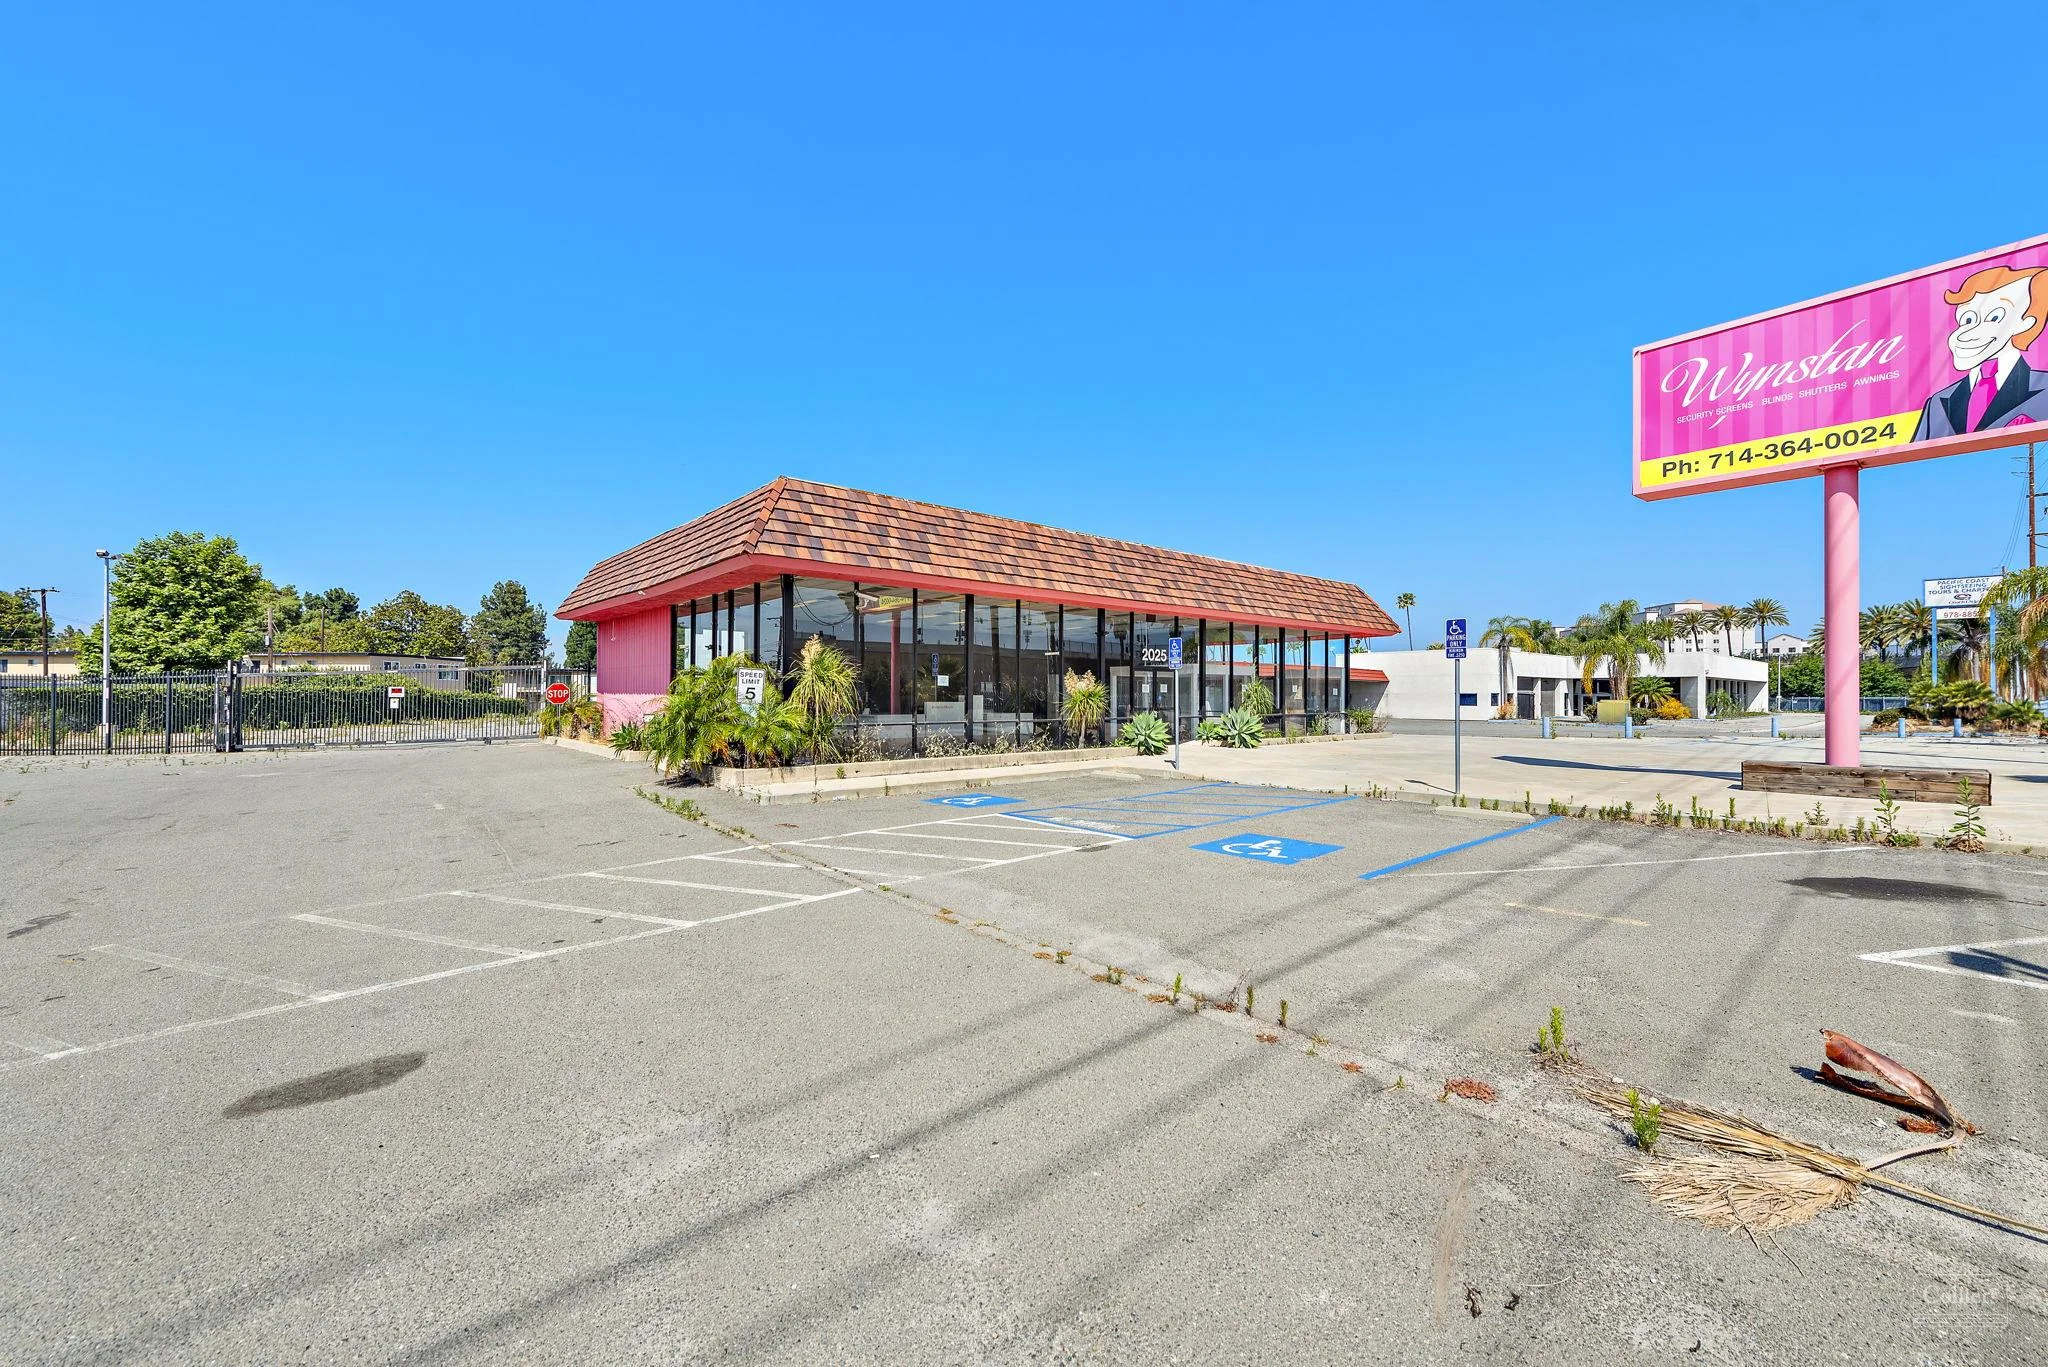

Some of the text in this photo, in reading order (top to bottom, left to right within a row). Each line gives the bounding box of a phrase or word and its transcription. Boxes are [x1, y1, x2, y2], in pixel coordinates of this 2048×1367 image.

[1661, 319, 1906, 429] Wynstan
[1676, 370, 1900, 424] SECURITY SCREENS BLINDS SHUTTERS AWNINGS
[1662, 422, 1897, 478] Ph: 714-364-0024
[1142, 648, 1167, 661] 2025
[740, 671, 764, 679] SPEED
[547, 689, 569, 698] STOP
[745, 687, 756, 700] 5
